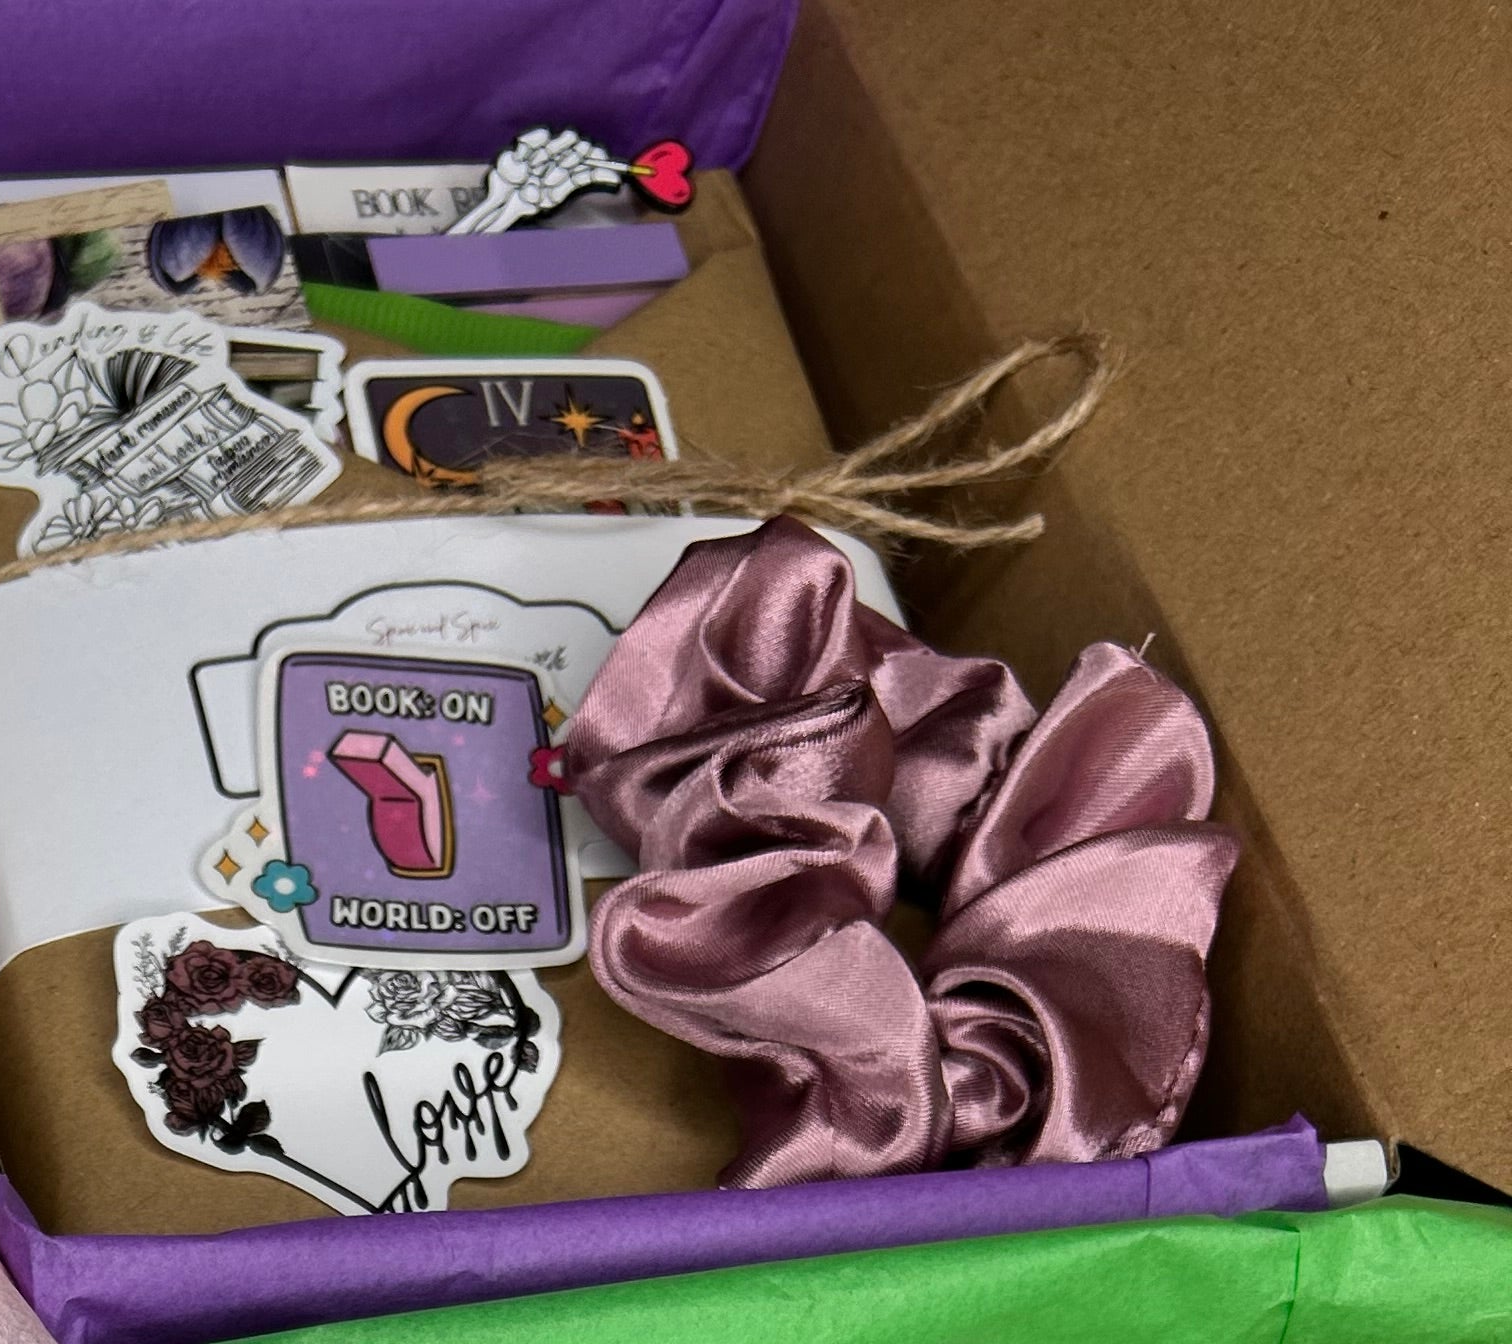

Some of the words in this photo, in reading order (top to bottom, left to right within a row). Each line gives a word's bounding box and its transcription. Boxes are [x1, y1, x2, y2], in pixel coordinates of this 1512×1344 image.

[352, 188, 440, 218] BOOK
[480, 380, 535, 427] IV
[326, 681, 436, 719] BOOK:
[441, 689, 495, 725] ON
[332, 898, 464, 934] WORLD:
[471, 903, 539, 934] OFF
